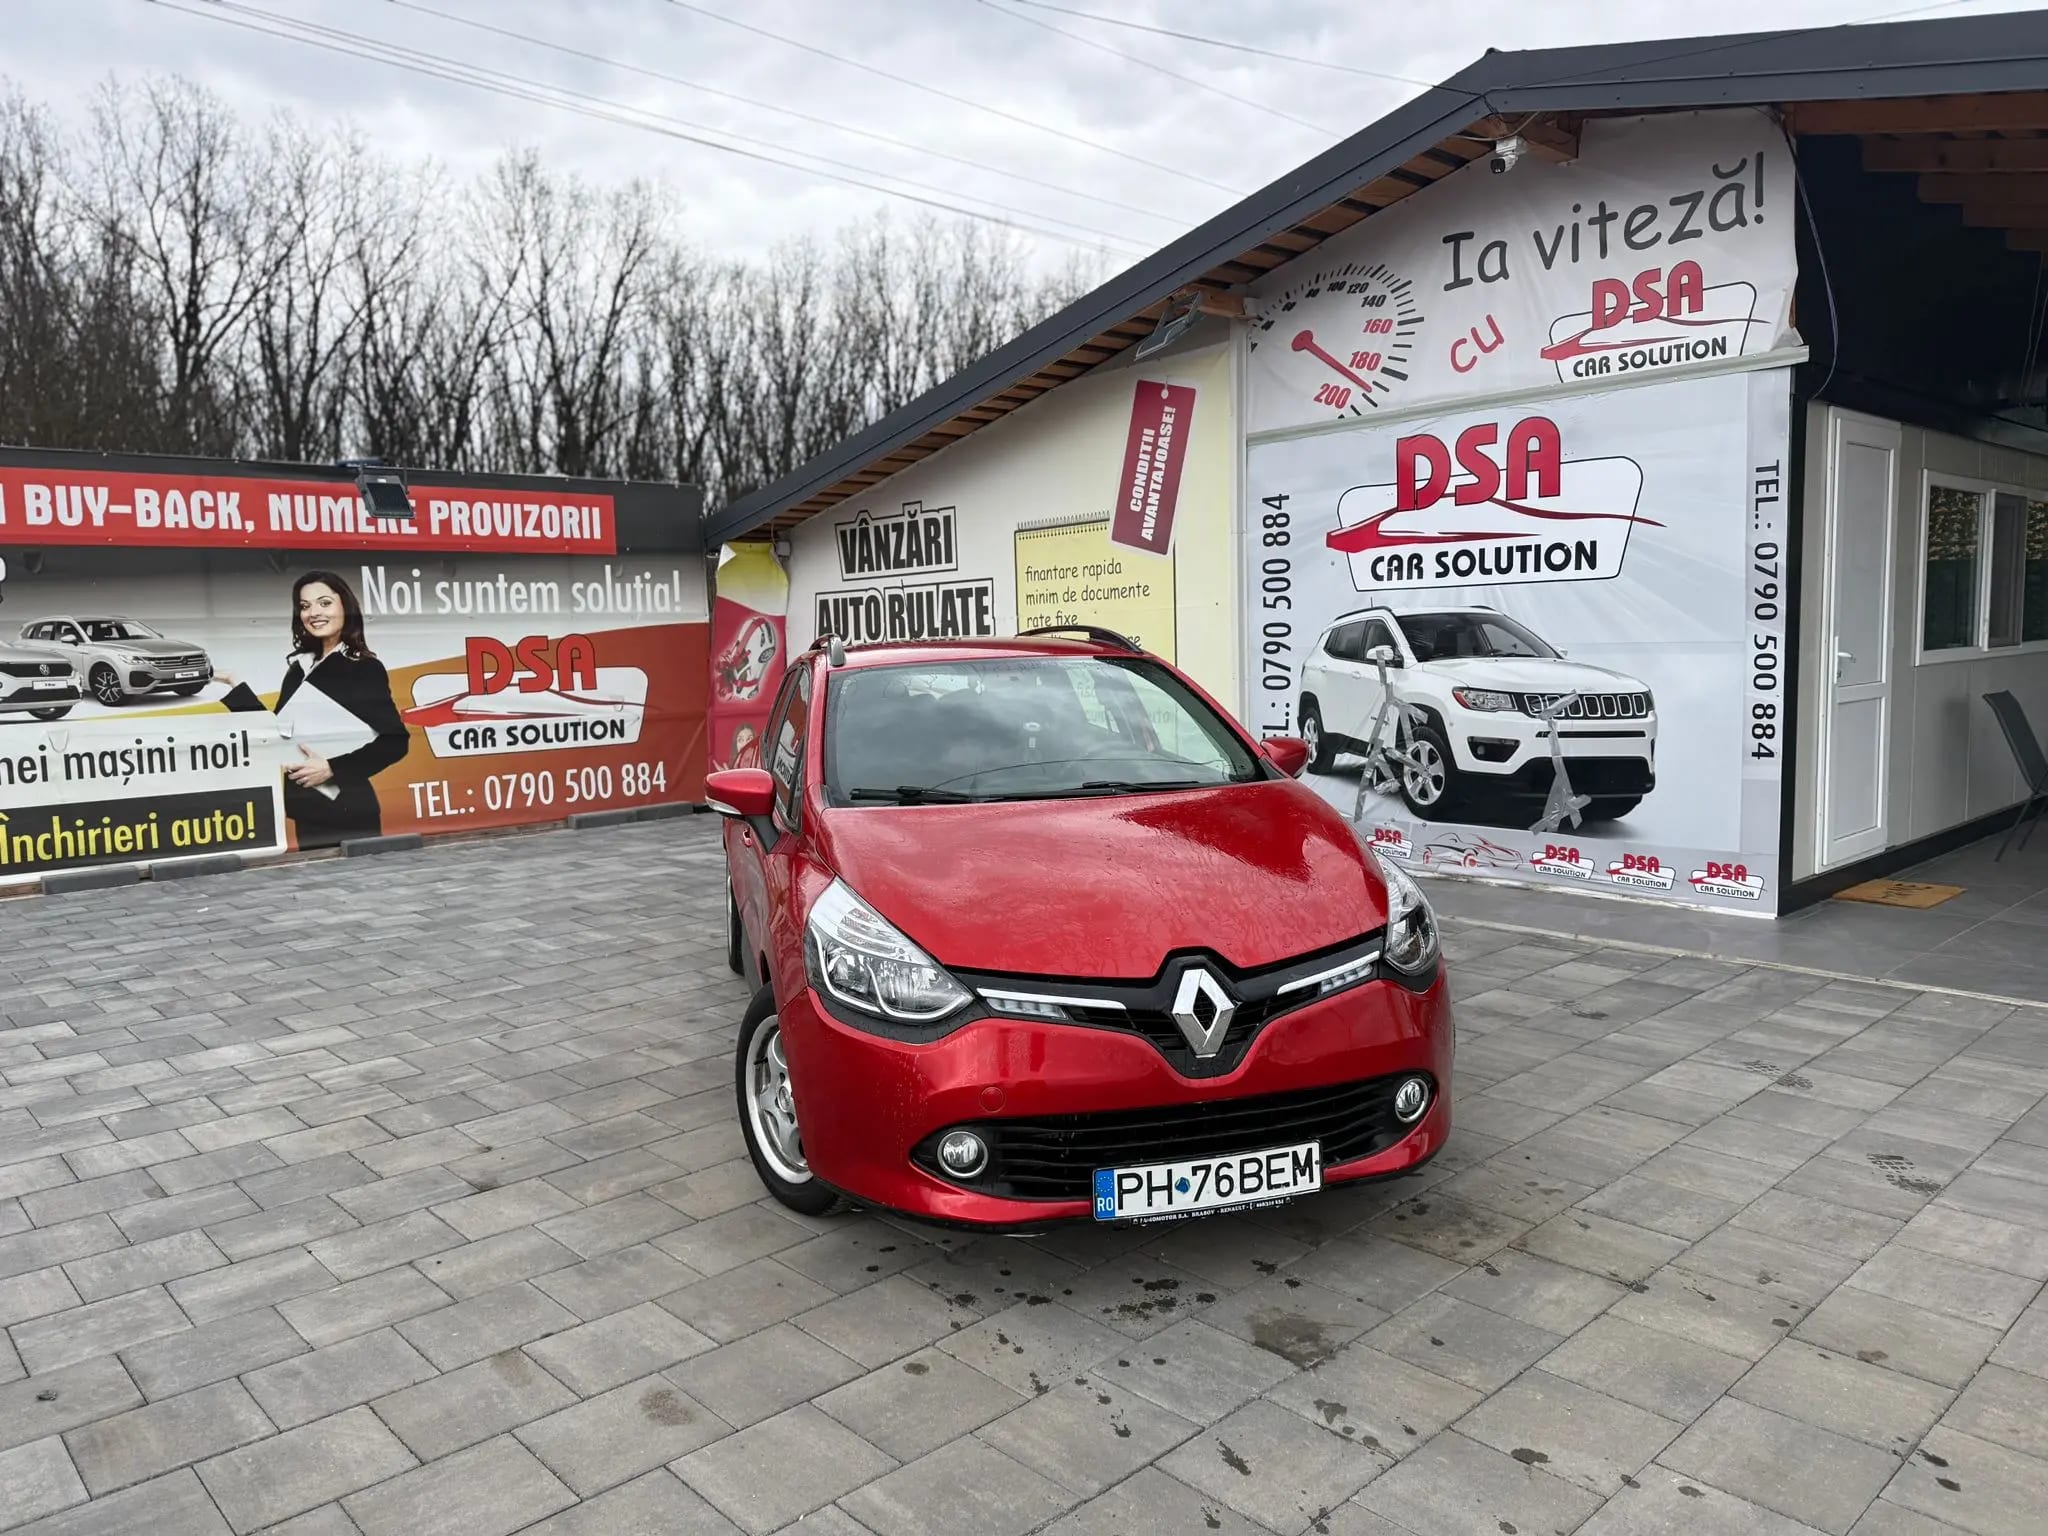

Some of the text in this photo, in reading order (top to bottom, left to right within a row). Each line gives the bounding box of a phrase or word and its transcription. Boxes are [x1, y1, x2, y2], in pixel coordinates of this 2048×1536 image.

[1443, 151, 1764, 291] Ia viteză!
[1327, 281, 1347, 292] 100
[1347, 282, 1369, 294] 120
[1361, 295, 1386, 308] 140
[1592, 260, 1704, 330] DSA
[1363, 319, 1393, 334] 160
[1450, 314, 1504, 373] cu
[1350, 351, 1381, 371] 180
[1573, 336, 1727, 378] CAR SOLUTION
[1314, 383, 1352, 409] 200
[1130, 428, 1155, 512] CONDITII
[1141, 406, 1176, 541] AVANTAJOASE!
[1397, 416, 1562, 513] DSA
[24, 484, 255, 533] BUY-BACK,
[429, 500, 601, 539] PROVIZORII
[1262, 494, 1290, 547] 884
[839, 509, 953, 574] VÂNZĂRI
[1371, 540, 1597, 581] CAR SOLUTION
[361, 565, 423, 614] Noi
[435, 573, 561, 613] suntem
[1025, 558, 1122, 582] finantare rapida
[1262, 558, 1292, 609] 500
[818, 586, 991, 643] AUTO RULATE
[1026, 582, 1150, 606] minim de documente
[1751, 459, 1780, 760] TEL.: 0790 500 884
[1027, 610, 1078, 628] rate fixe
[465, 633, 597, 695] DSA
[1262, 622, 1292, 690] 0790
[449, 719, 625, 750] CAR SOLUTION
[65, 736, 176, 785] mașini
[190, 730, 250, 772] noi!
[408, 761, 667, 818] TEL.: 0790 500 884
[171, 801, 256, 847] auto!
[1375, 828, 1402, 844] DSA
[1546, 844, 1580, 864] DSA
[1553, 867, 1587, 879] SOLUTION
[1624, 853, 1660, 873] DSA
[1707, 861, 1747, 882] DSA
[1617, 875, 1668, 888] CAR SOLUTION
[1717, 887, 1755, 898] SOLUTION
[1116, 1148, 1314, 1211] PH 76BEM
[1097, 1198, 1113, 1212] RO
